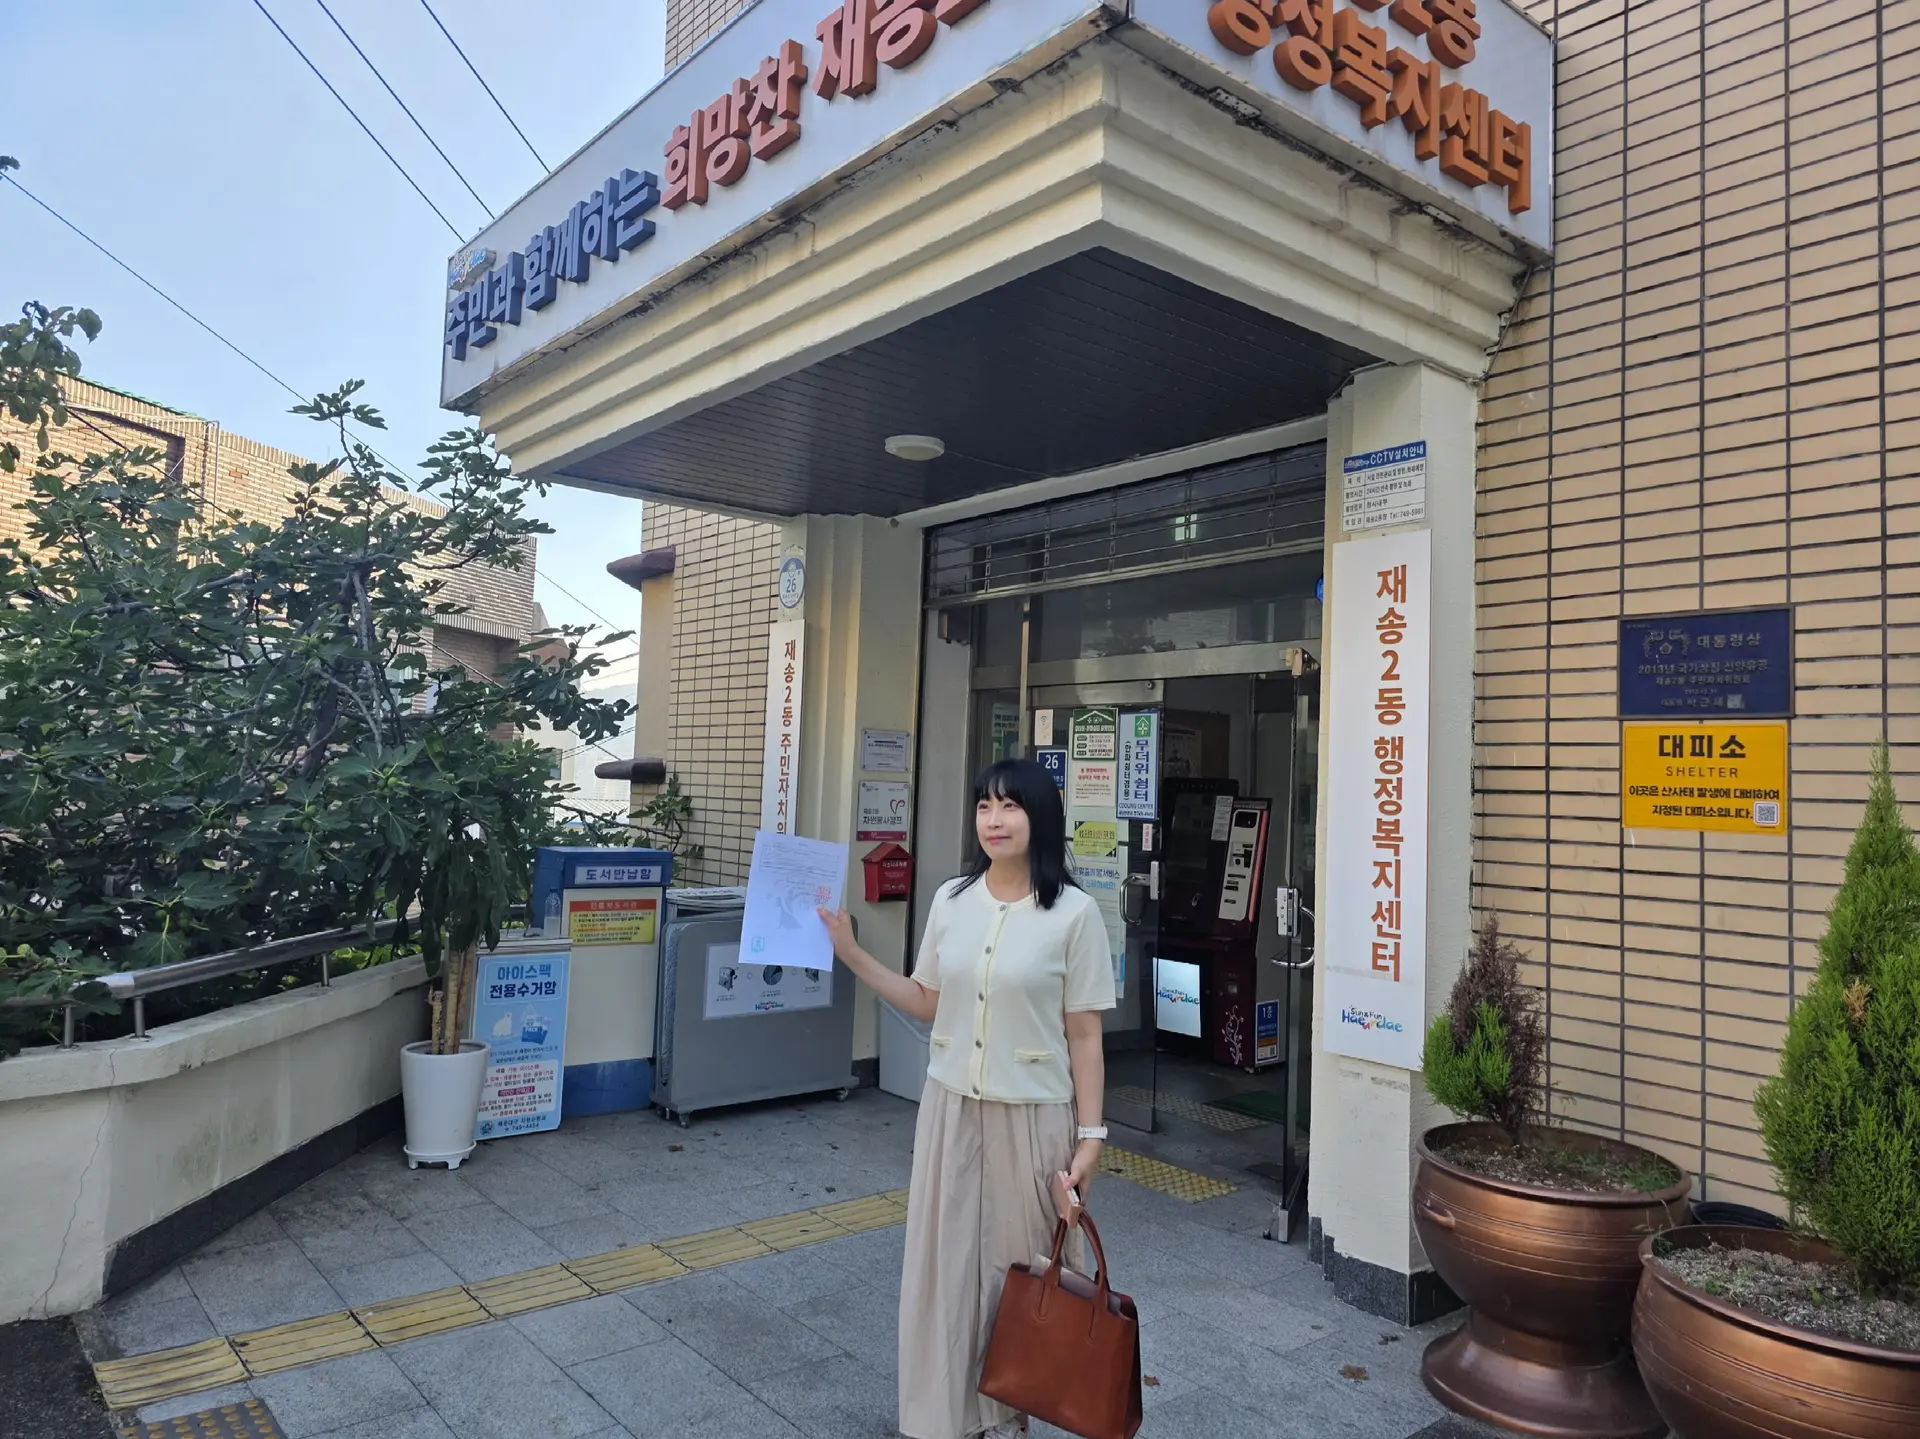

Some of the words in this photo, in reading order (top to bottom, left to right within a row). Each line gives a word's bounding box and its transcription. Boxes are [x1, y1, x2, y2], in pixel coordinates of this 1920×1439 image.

[445, 252, 526, 361] 주민과
[525, 168, 661, 311] 함께하는
[661, 39, 808, 210] 희망찬
[786, 578, 796, 593] 26
[1373, 564, 1408, 725] 재송2동
[1697, 633, 1762, 648] 대통령상
[1638, 663, 1675, 675] 2013년
[781, 639, 796, 728] 재송2동
[1658, 734, 1746, 759] 대피소
[1045, 754, 1059, 769] 26
[1134, 740, 1149, 775] 무더위
[1665, 766, 1739, 778] SHELTER
[1133, 778, 1148, 802] 쉼터
[1629, 785, 1659, 797] 이곳은
[1661, 786, 1694, 798] 산사태
[1697, 787, 1731, 799] 발생에
[1734, 788, 1780, 800] 대비하여
[1652, 804, 1683, 816] 지정된
[1685, 806, 1753, 819] 대피소입니다.
[1371, 736, 1404, 982] 행정복지센터
[586, 868, 652, 880] 도서반납함
[497, 964, 552, 981] 아이스팩
[489, 981, 557, 999] 전용수거함
